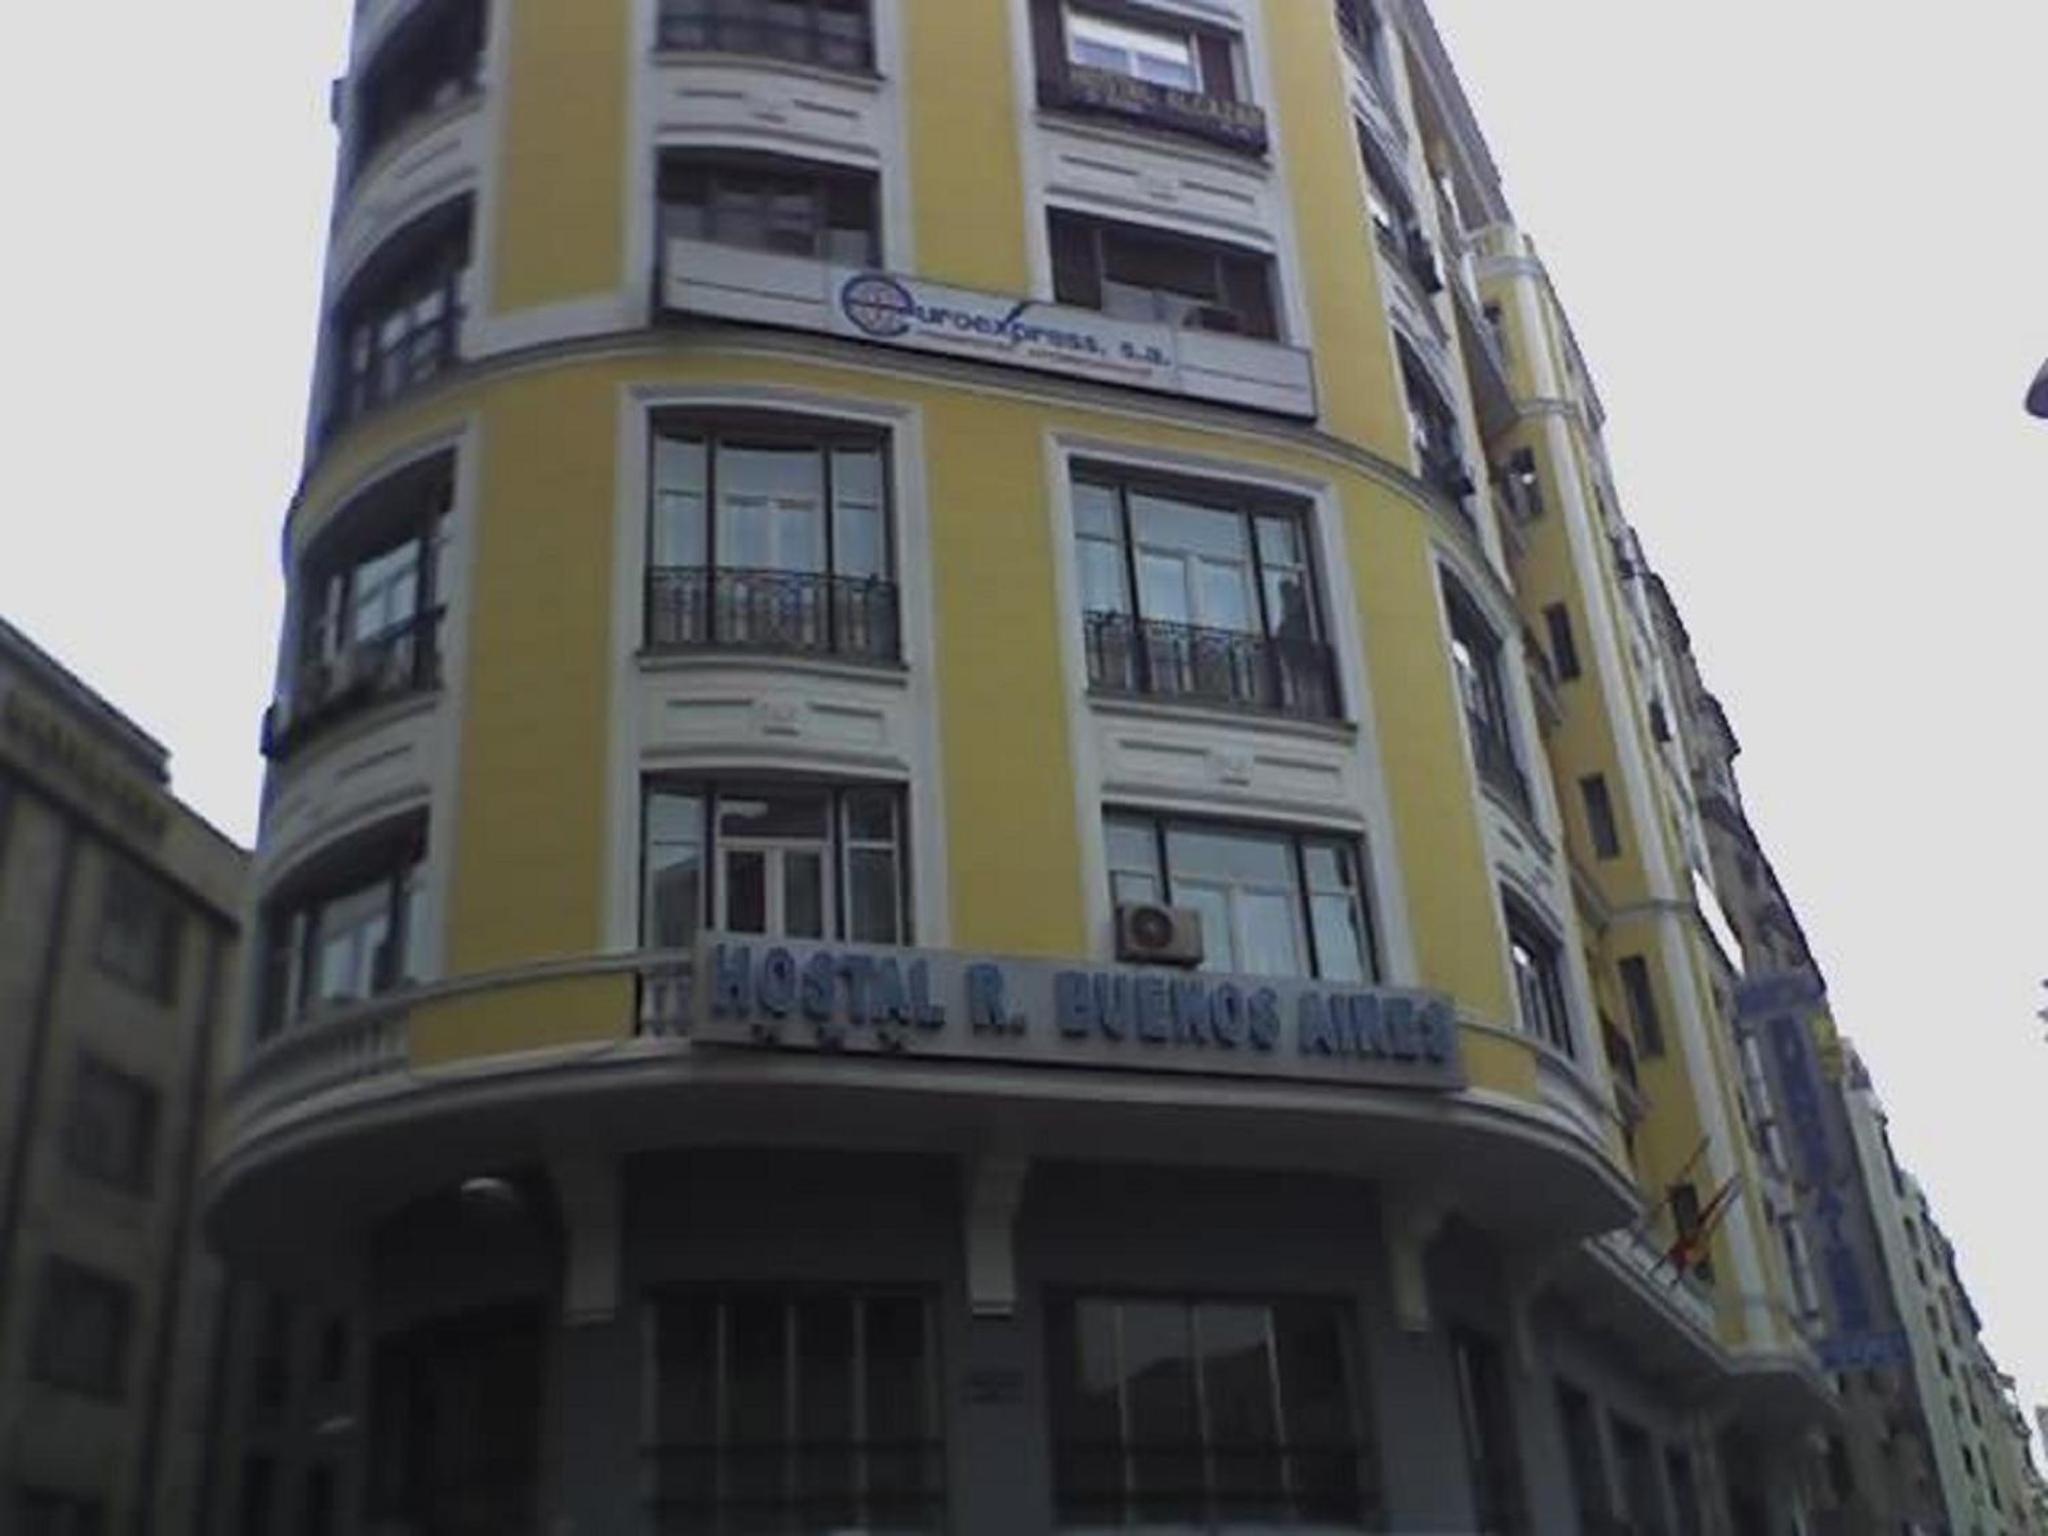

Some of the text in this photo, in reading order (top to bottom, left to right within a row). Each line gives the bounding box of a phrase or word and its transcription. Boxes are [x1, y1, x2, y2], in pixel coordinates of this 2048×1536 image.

[708, 942, 1454, 1064] HOSTAL R. BUENOS AIRES
